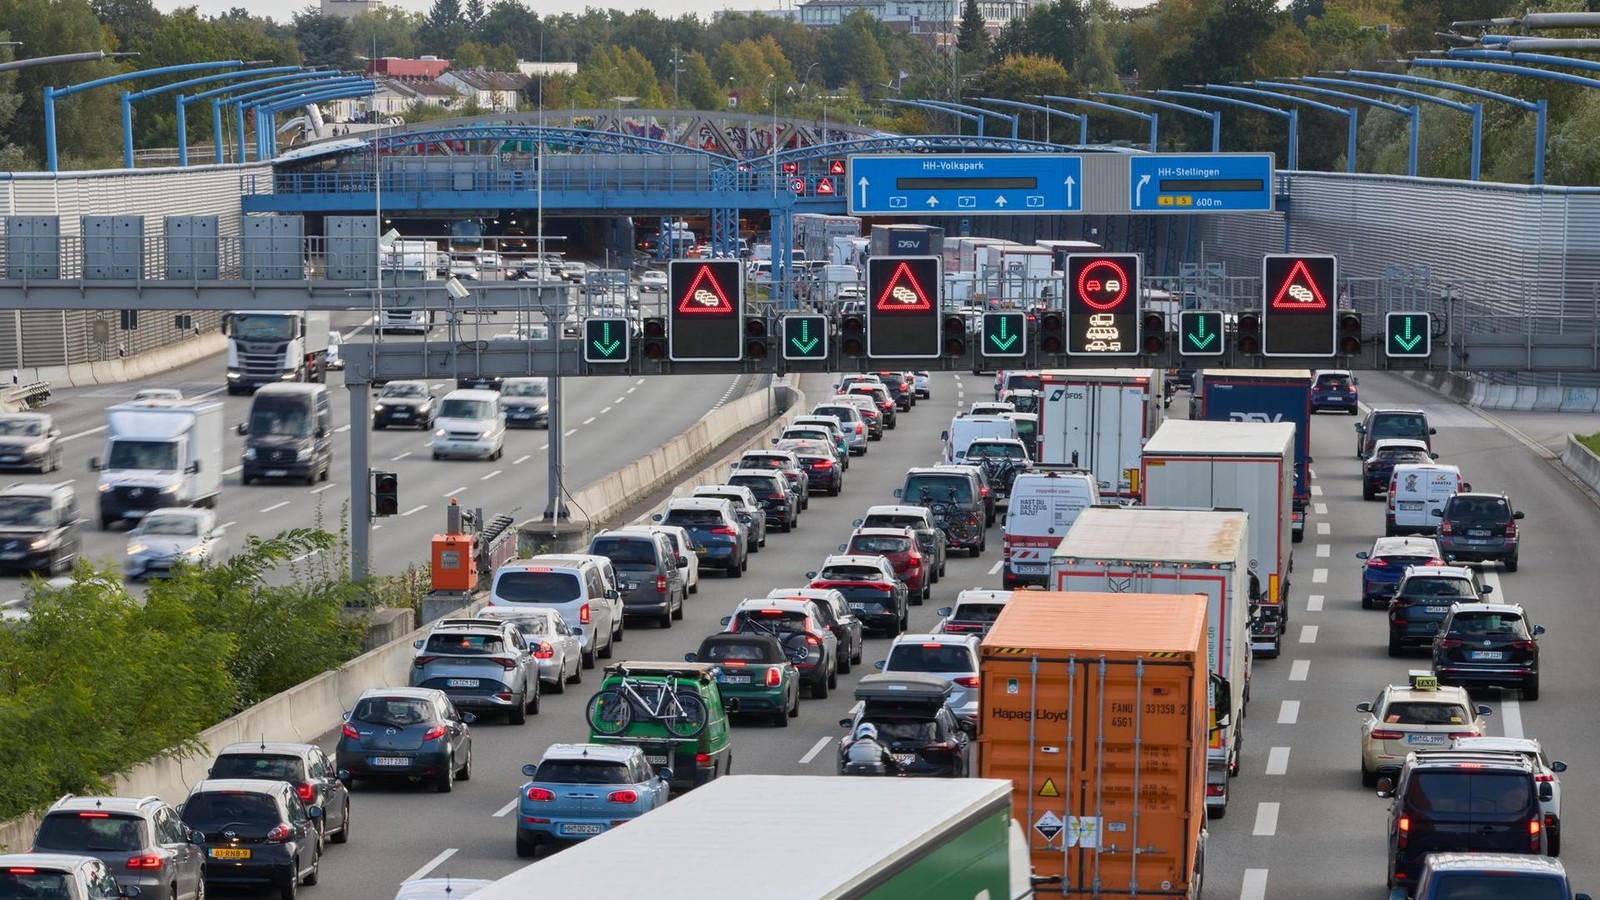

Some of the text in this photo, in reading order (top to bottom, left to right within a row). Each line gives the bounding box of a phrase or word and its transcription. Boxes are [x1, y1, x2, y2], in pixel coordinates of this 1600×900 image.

[922, 161, 984, 171] HH-Volkspark
[1158, 168, 1220, 177] HH-Stellingen
[1196, 198, 1212, 206] 600
[898, 240, 920, 248] DSV
[1112, 703, 1187, 715] FANU 331358 2
[586, 825, 599, 833] 247
